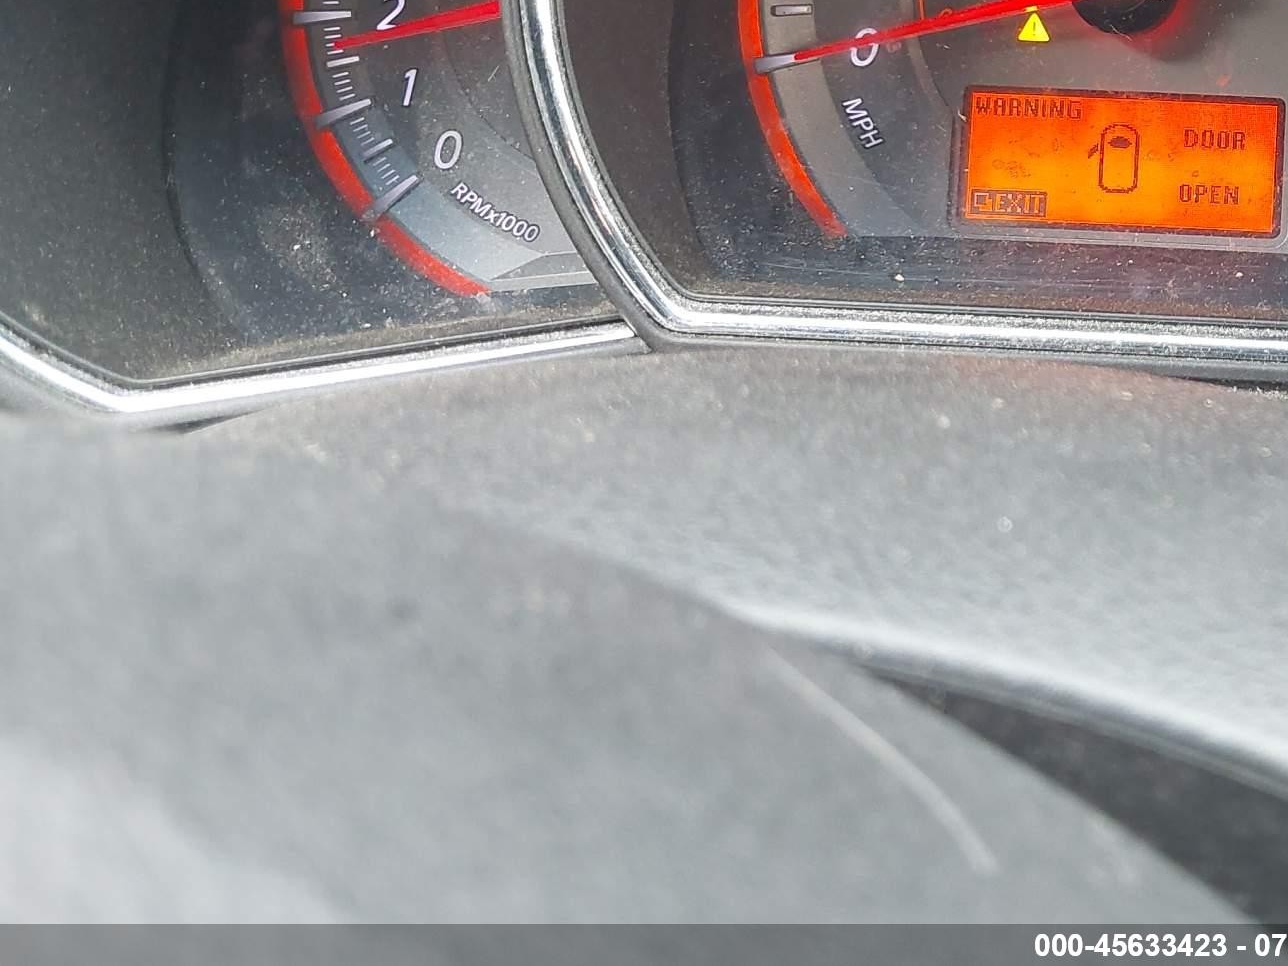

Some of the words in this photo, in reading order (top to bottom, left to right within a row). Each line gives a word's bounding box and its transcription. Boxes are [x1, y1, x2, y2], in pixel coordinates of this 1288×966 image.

[849, 27, 880, 67] 0
[401, 69, 418, 106] 1
[842, 97, 883, 148] MPH
[976, 97, 1082, 120] WARNING
[434, 130, 463, 170] 0
[1184, 128, 1246, 151] DOOR
[997, 192, 1045, 214] EXIT
[1179, 183, 1240, 205] OPEN
